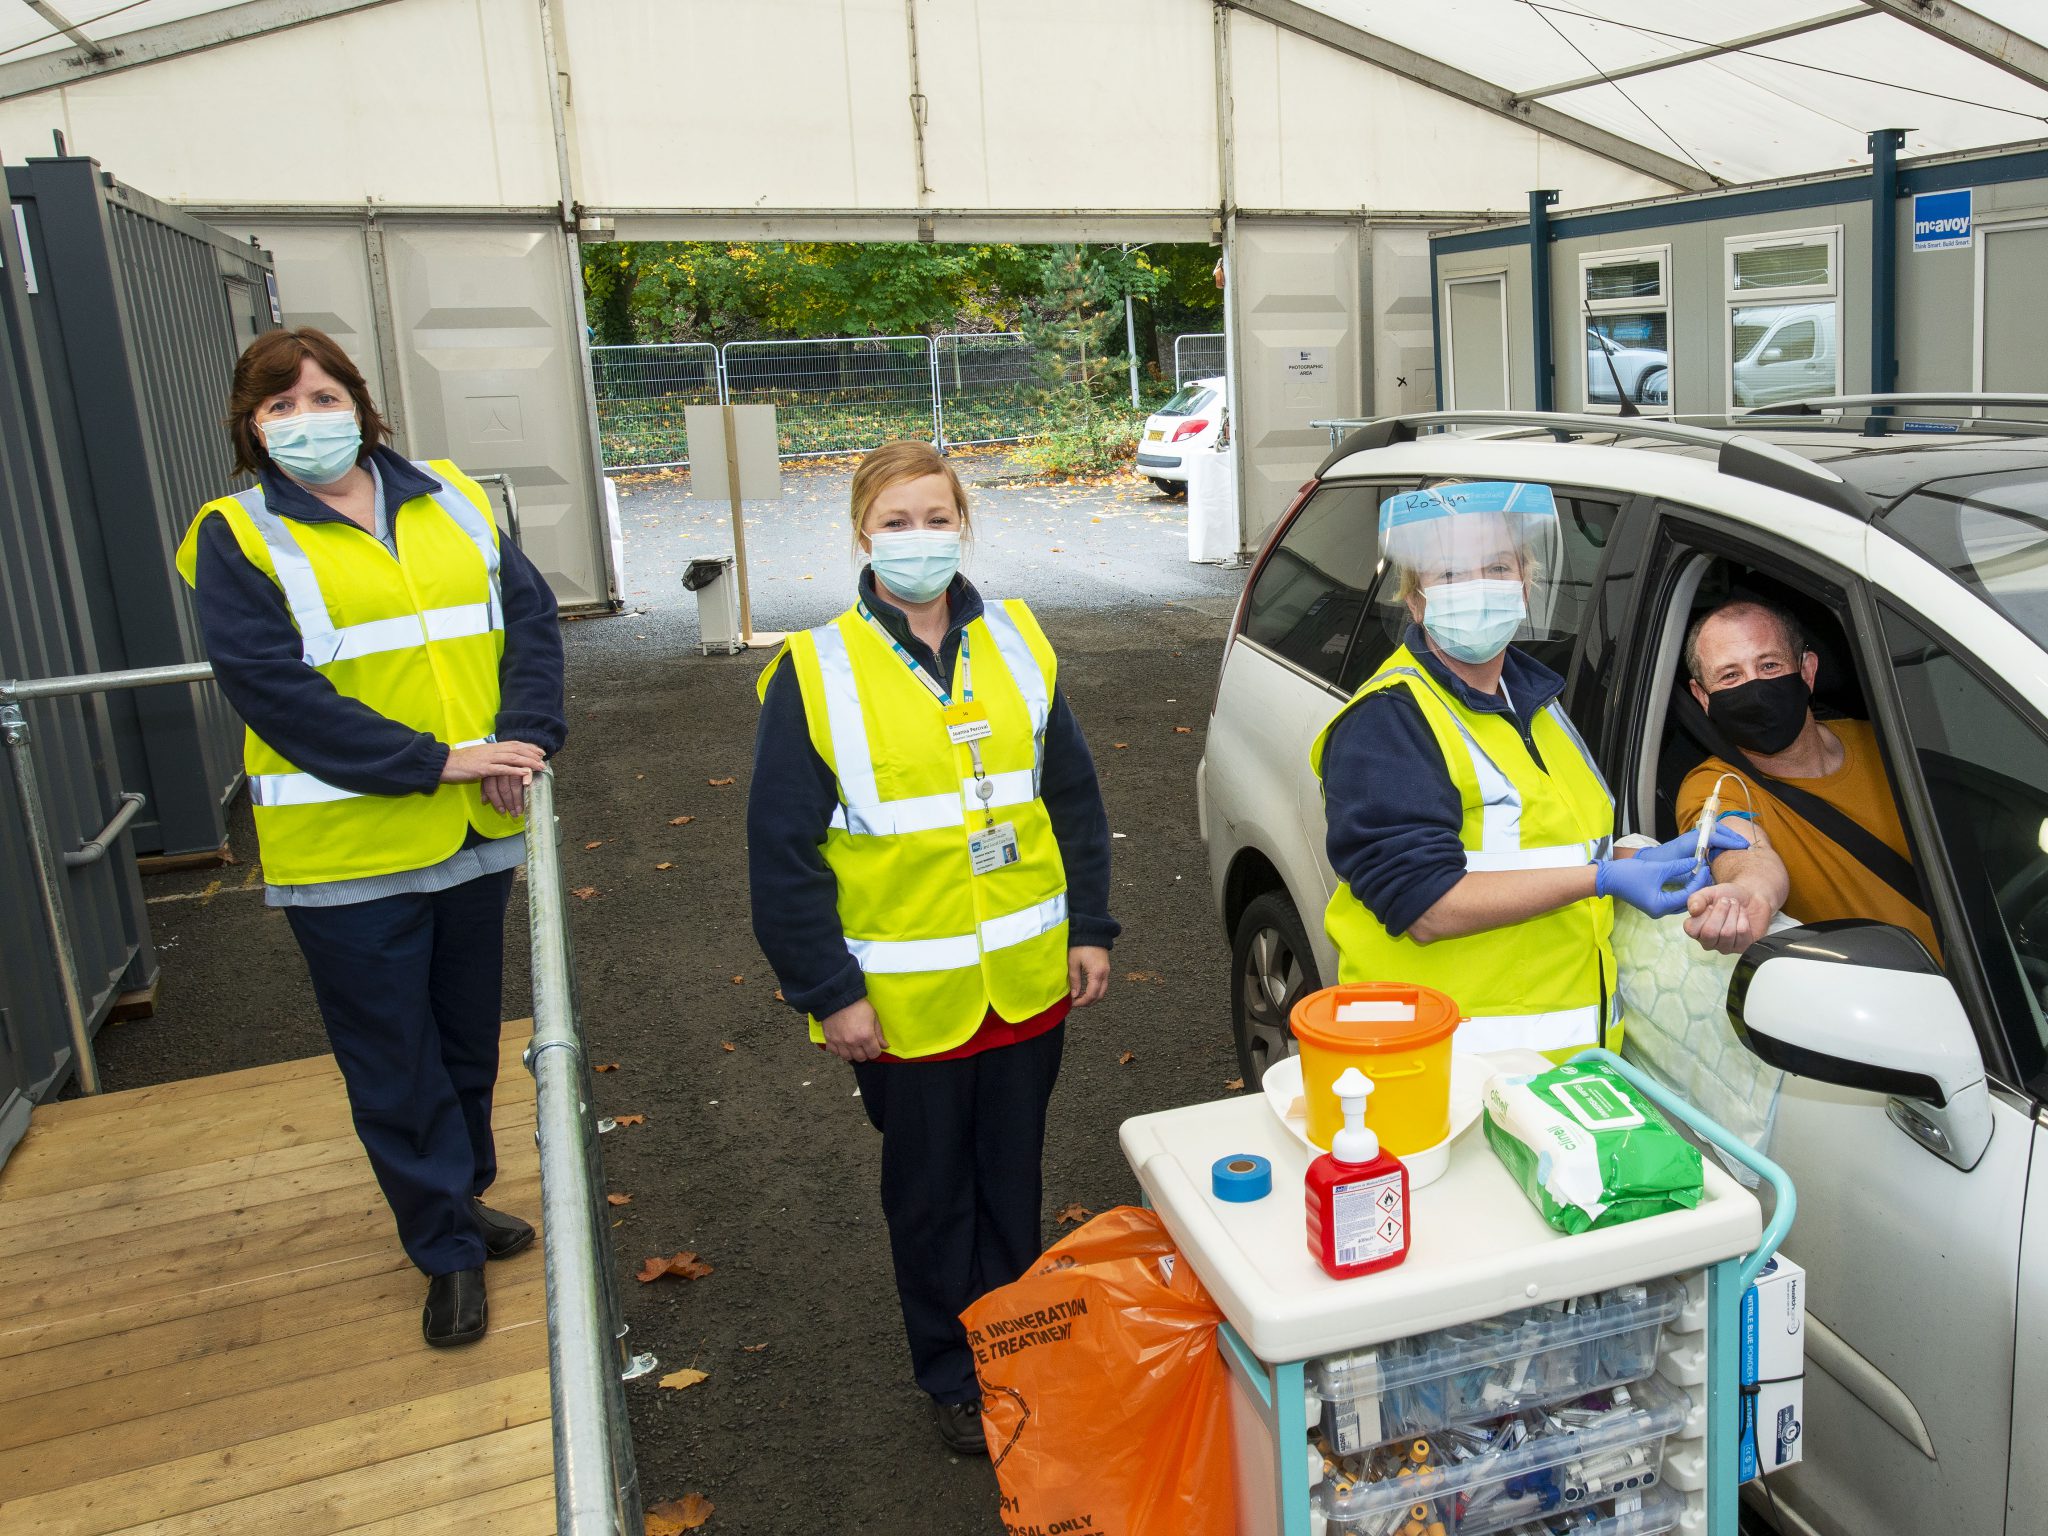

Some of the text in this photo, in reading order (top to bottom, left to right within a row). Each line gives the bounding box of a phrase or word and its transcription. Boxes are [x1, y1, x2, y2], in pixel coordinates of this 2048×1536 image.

[1916, 217, 1969, 234] mcavoy
[1405, 493, 1467, 513] Roslyn
[1546, 1125, 1577, 1151] clinell
[985, 1298, 1088, 1338] INCINERATION
[989, 1322, 1072, 1360] TREATMENT
[1048, 1514, 1092, 1535] ONLY
